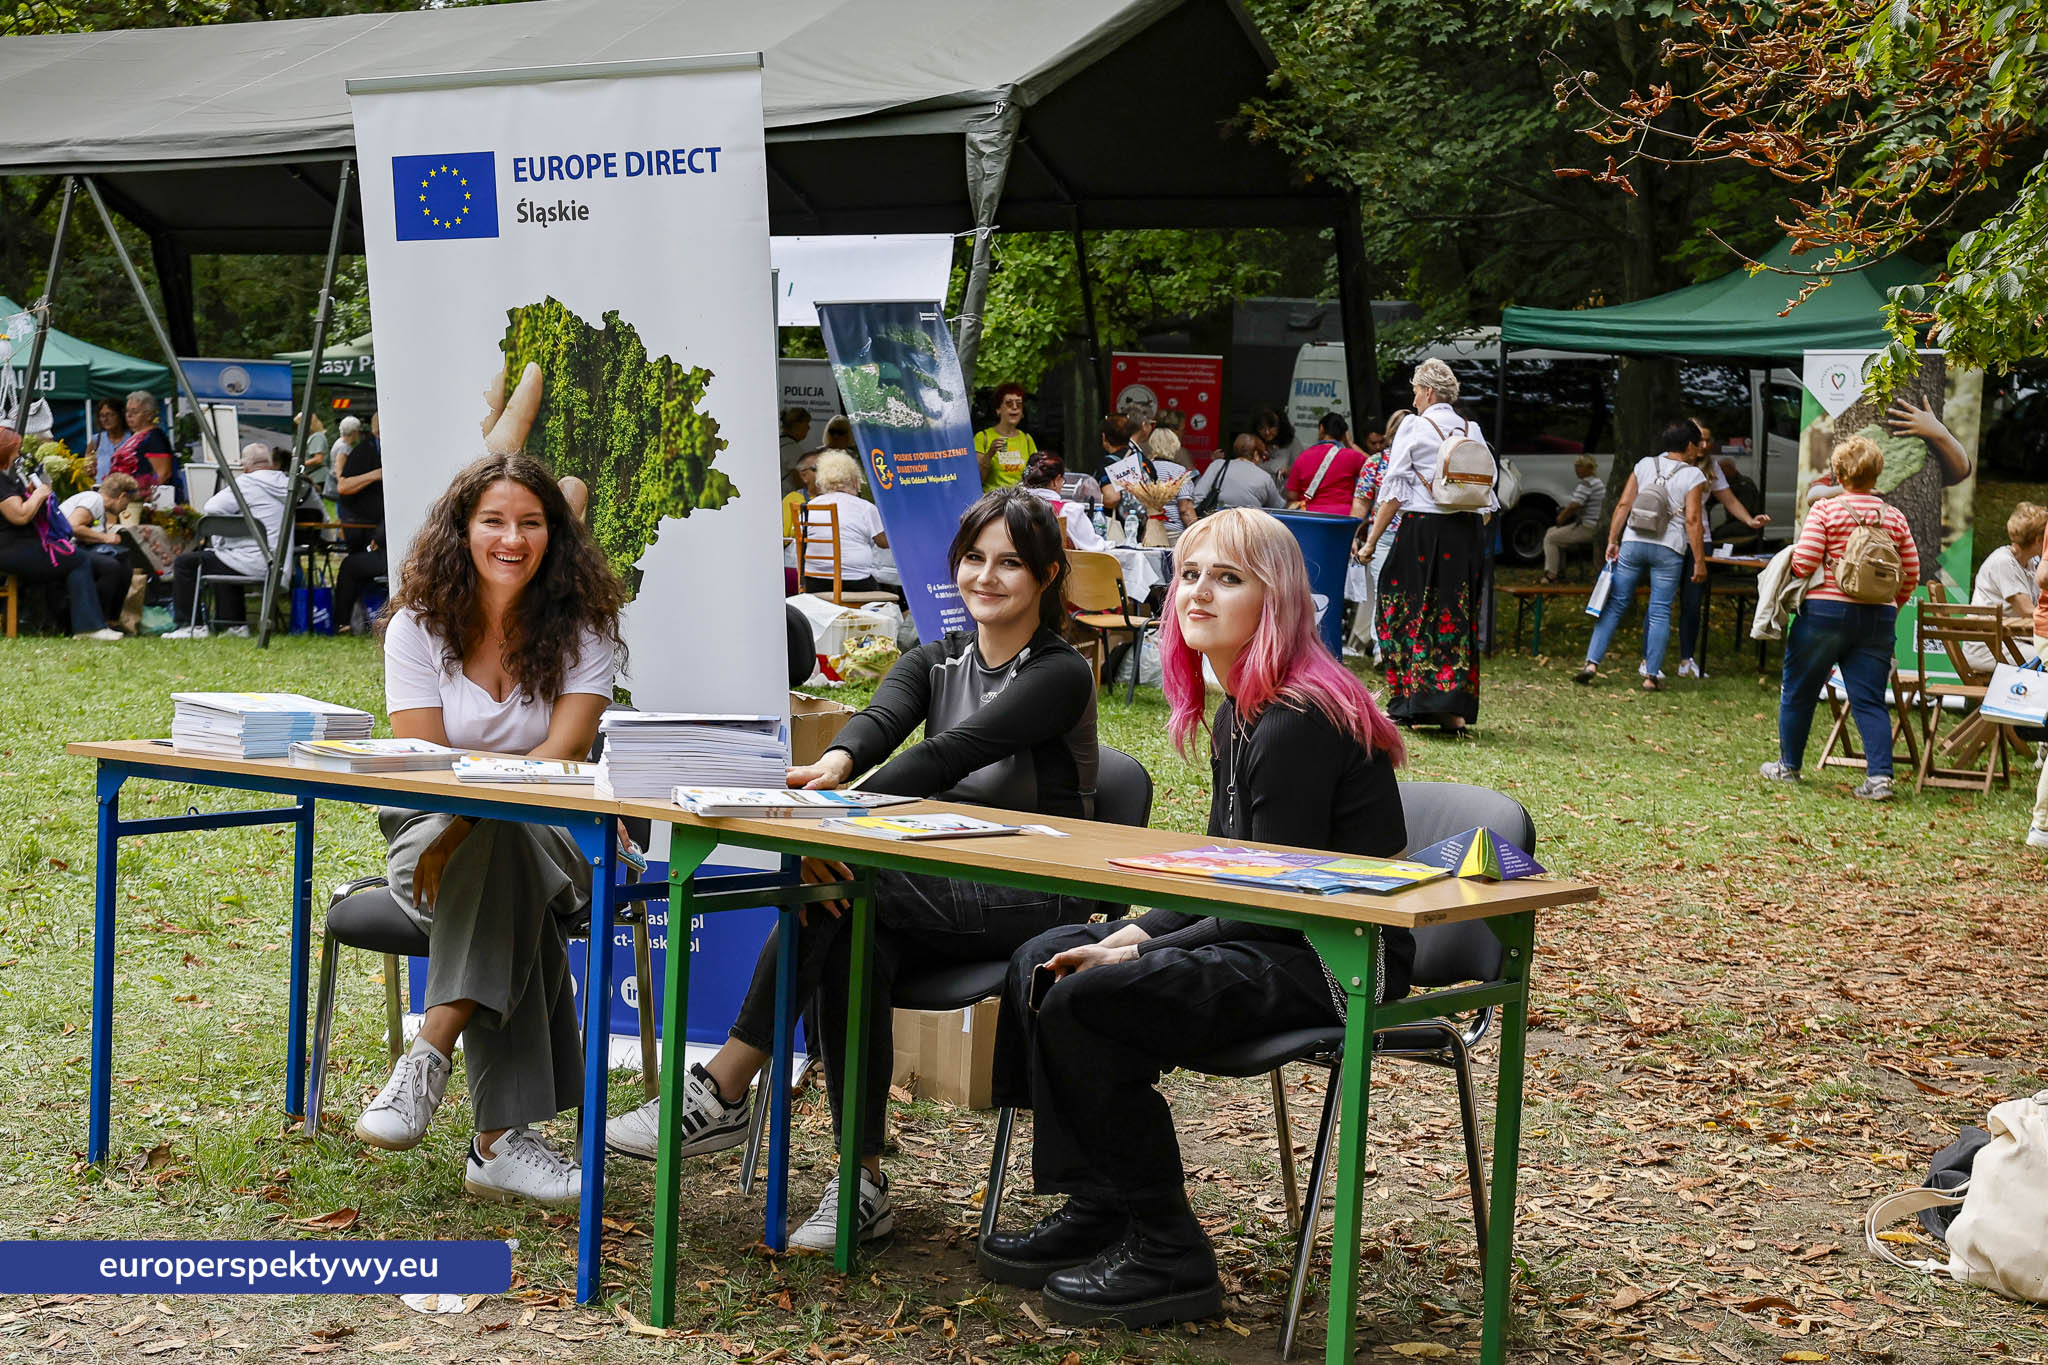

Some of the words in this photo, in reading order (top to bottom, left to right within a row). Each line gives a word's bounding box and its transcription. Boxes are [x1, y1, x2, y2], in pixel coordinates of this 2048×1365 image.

[513, 152, 618, 183] EUROPE
[625, 147, 721, 178] DIRECT
[517, 198, 590, 228] Śląskie
[319, 360, 354, 376] asy
[784, 386, 824, 397] POLICJA
